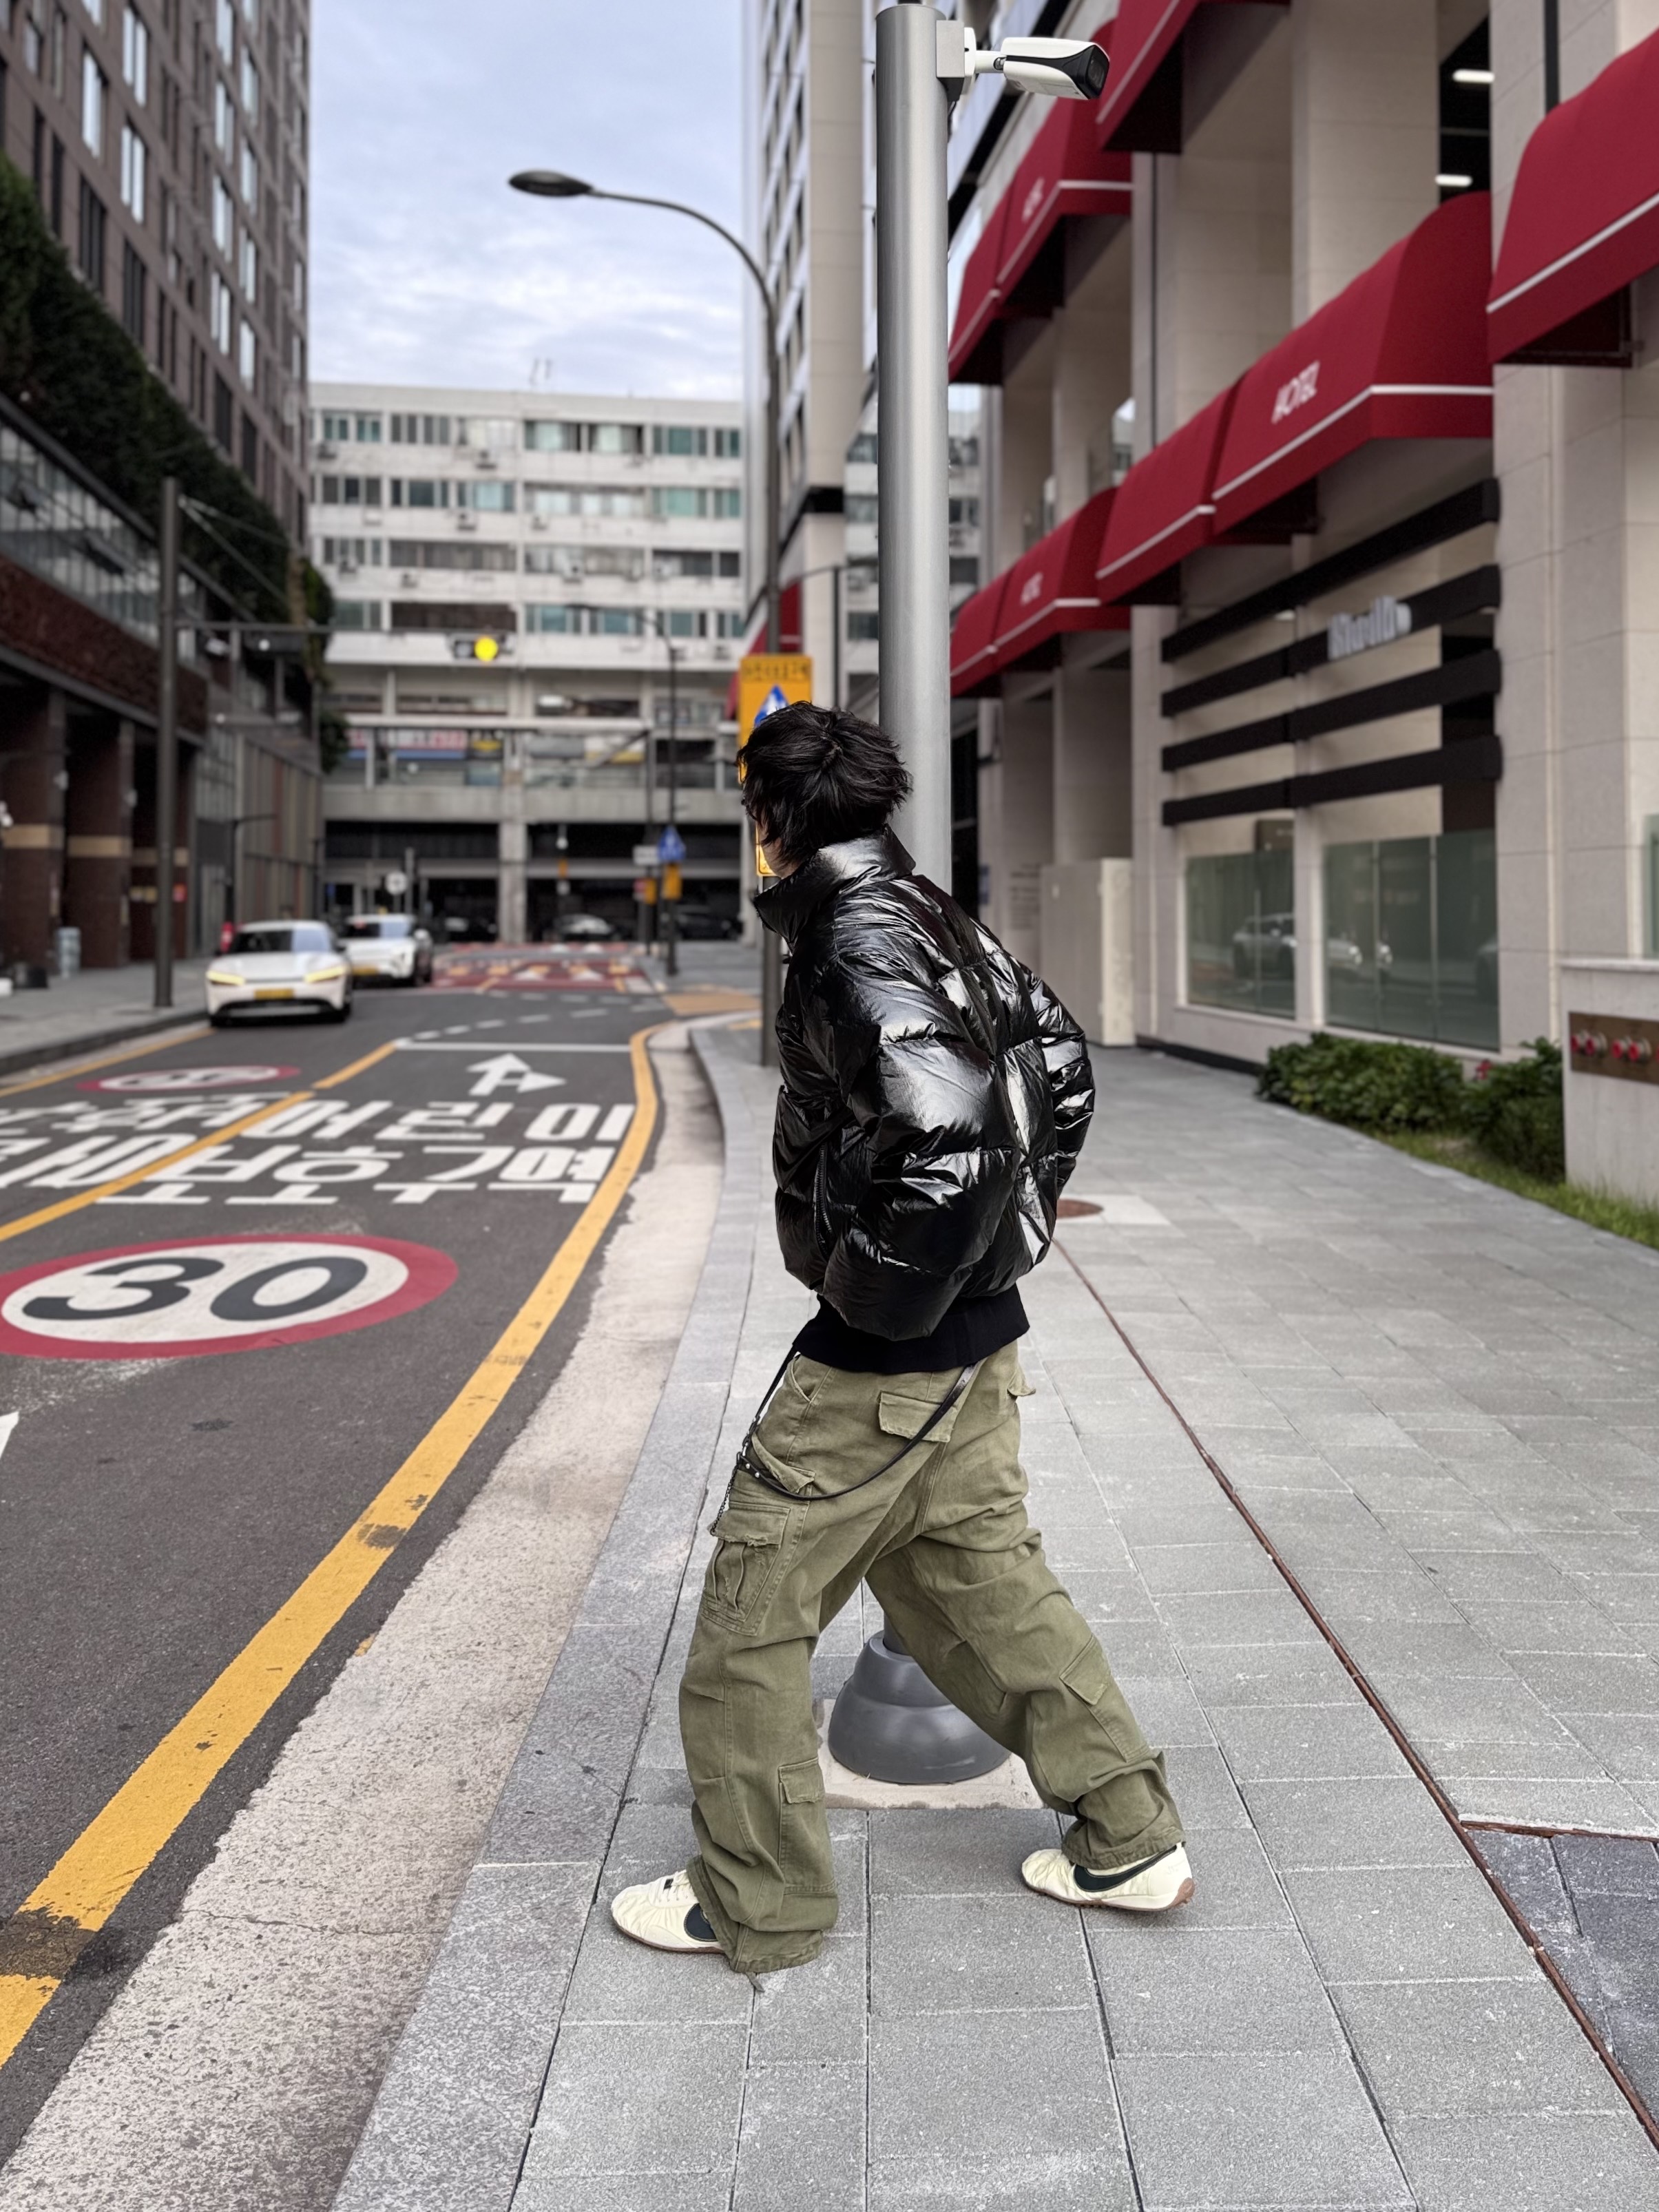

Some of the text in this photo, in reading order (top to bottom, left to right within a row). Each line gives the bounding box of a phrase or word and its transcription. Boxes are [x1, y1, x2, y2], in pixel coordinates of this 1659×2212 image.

[240, 1099, 635, 1141] 어린이
[95, 1144, 615, 1204] 보호구역
[23, 1256, 368, 1322] 30
